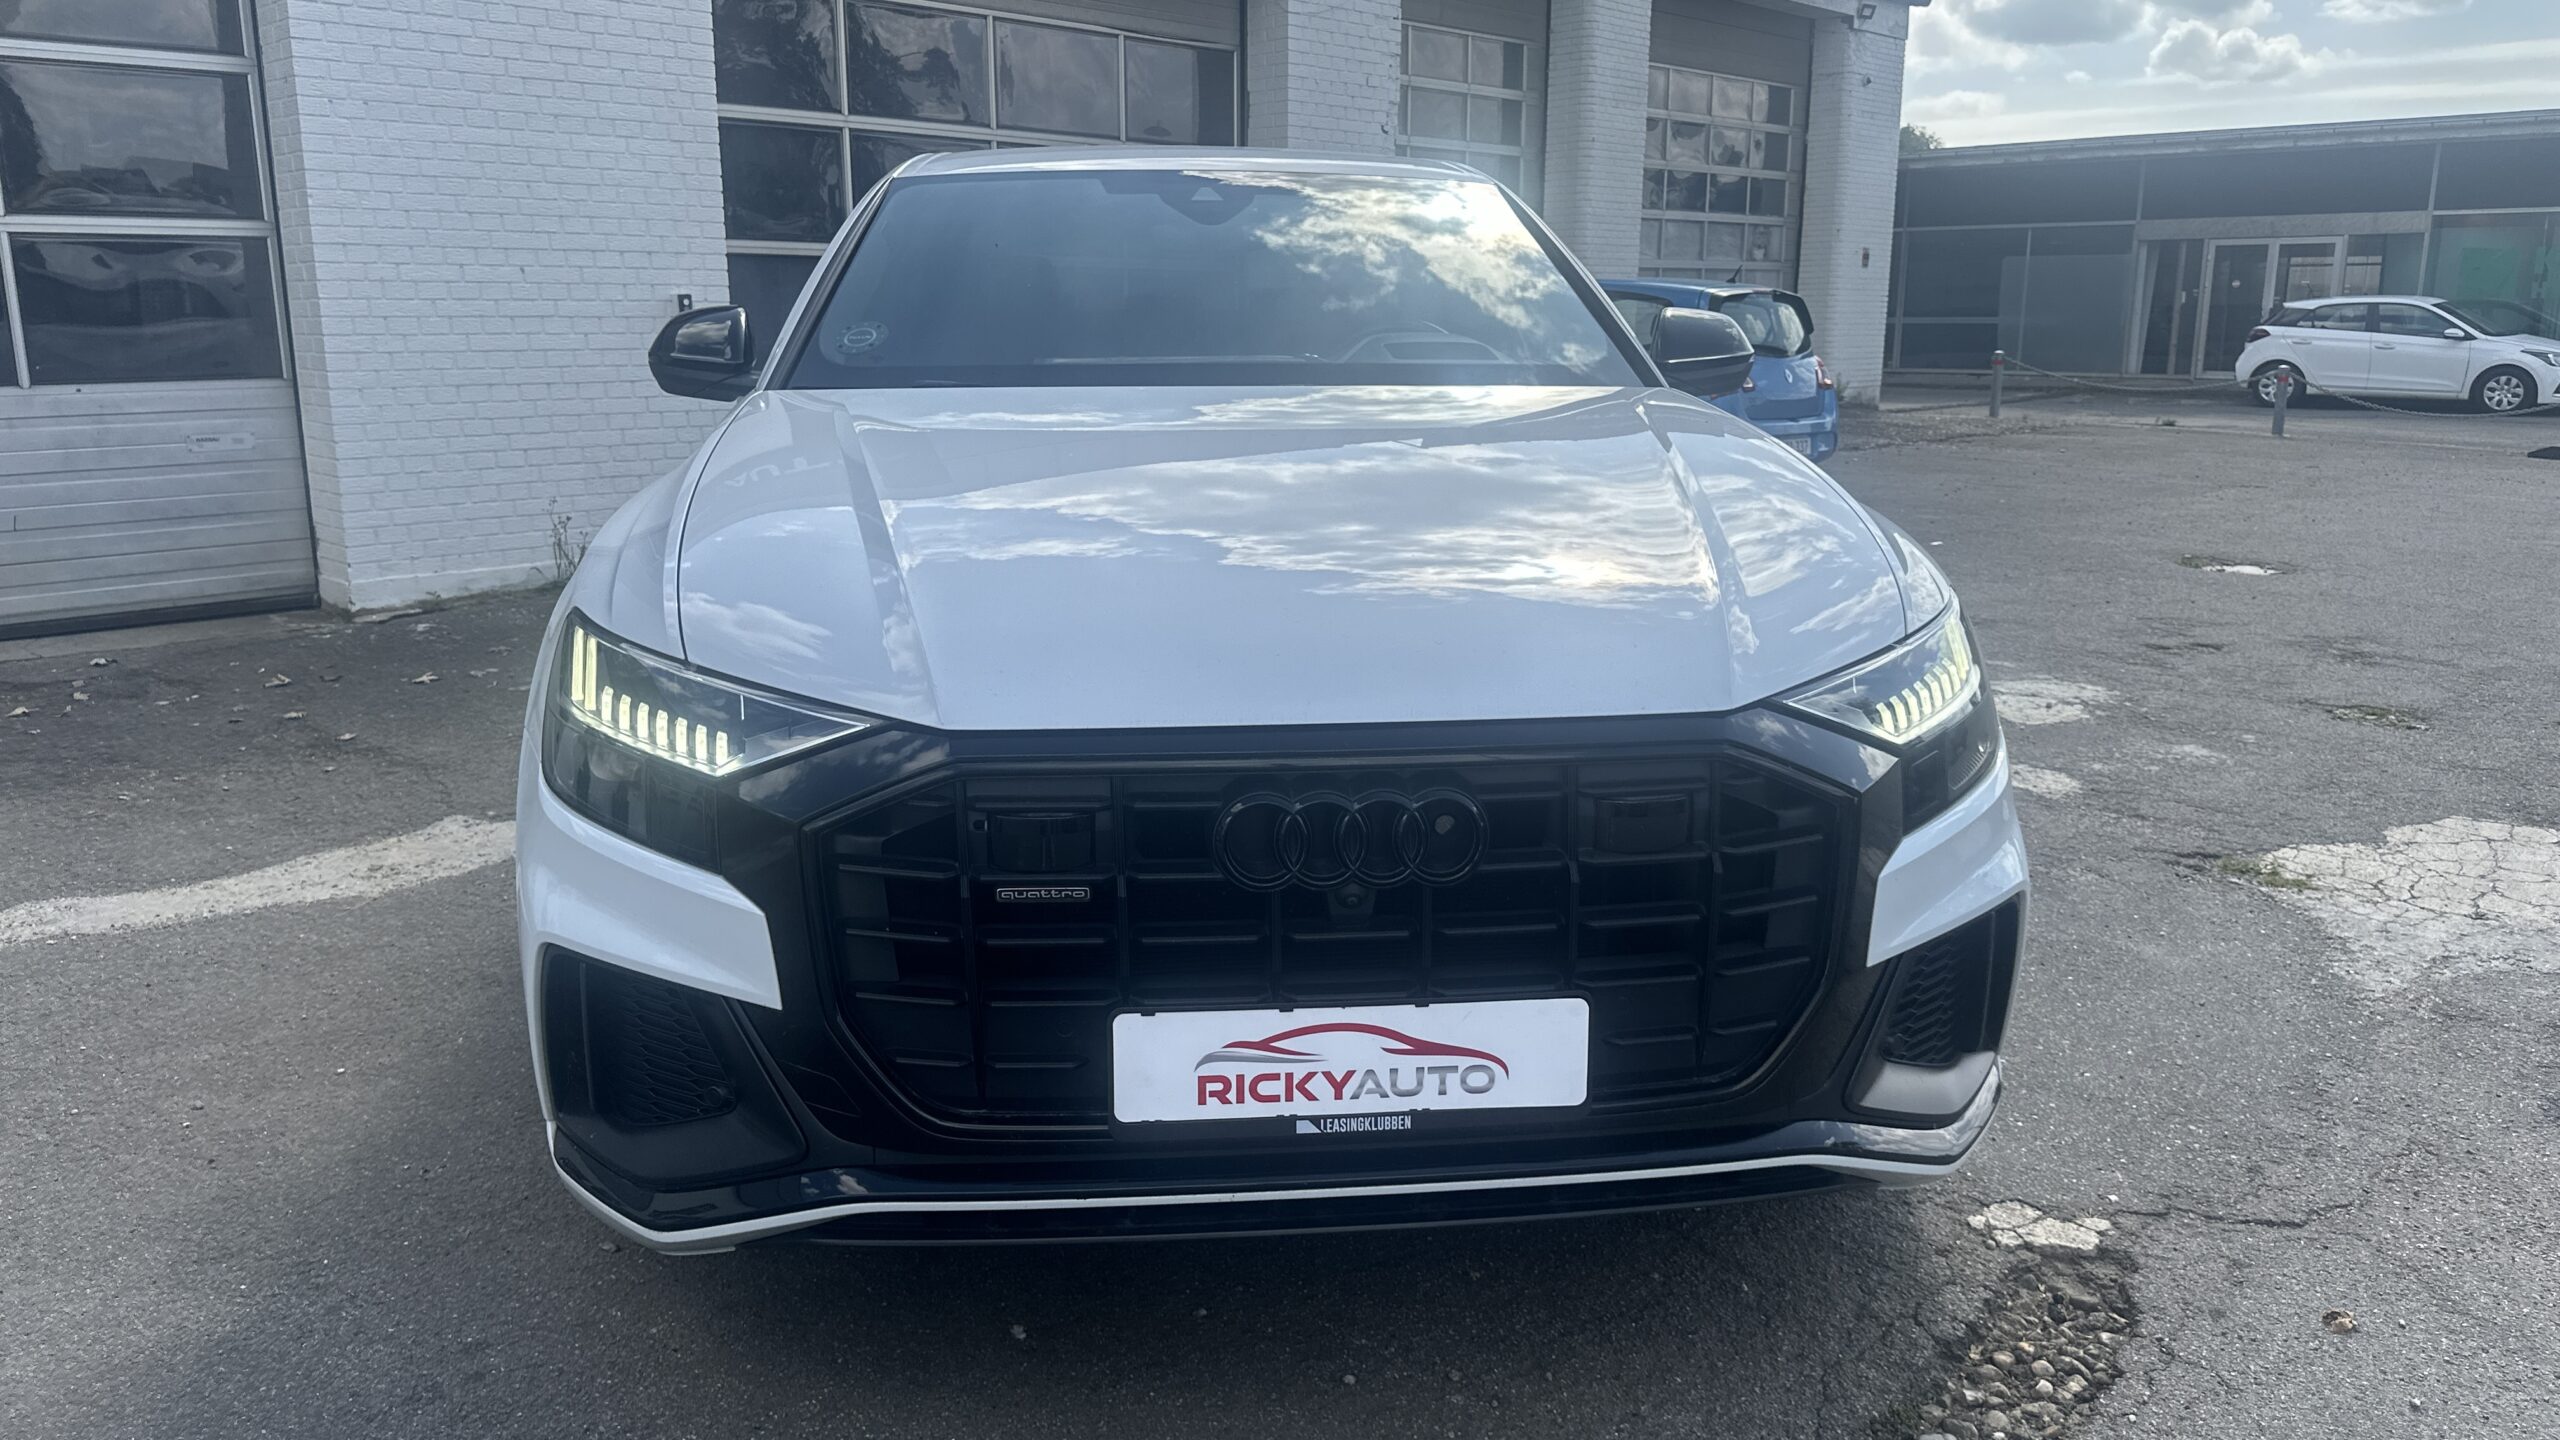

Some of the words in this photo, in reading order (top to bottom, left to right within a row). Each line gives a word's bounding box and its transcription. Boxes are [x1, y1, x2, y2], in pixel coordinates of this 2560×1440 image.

[1001, 889, 1085, 900] quattro
[1197, 1063, 1496, 1106] RICKYAUTO
[1320, 1115, 1411, 1133] LEASINGKLUBBEN
